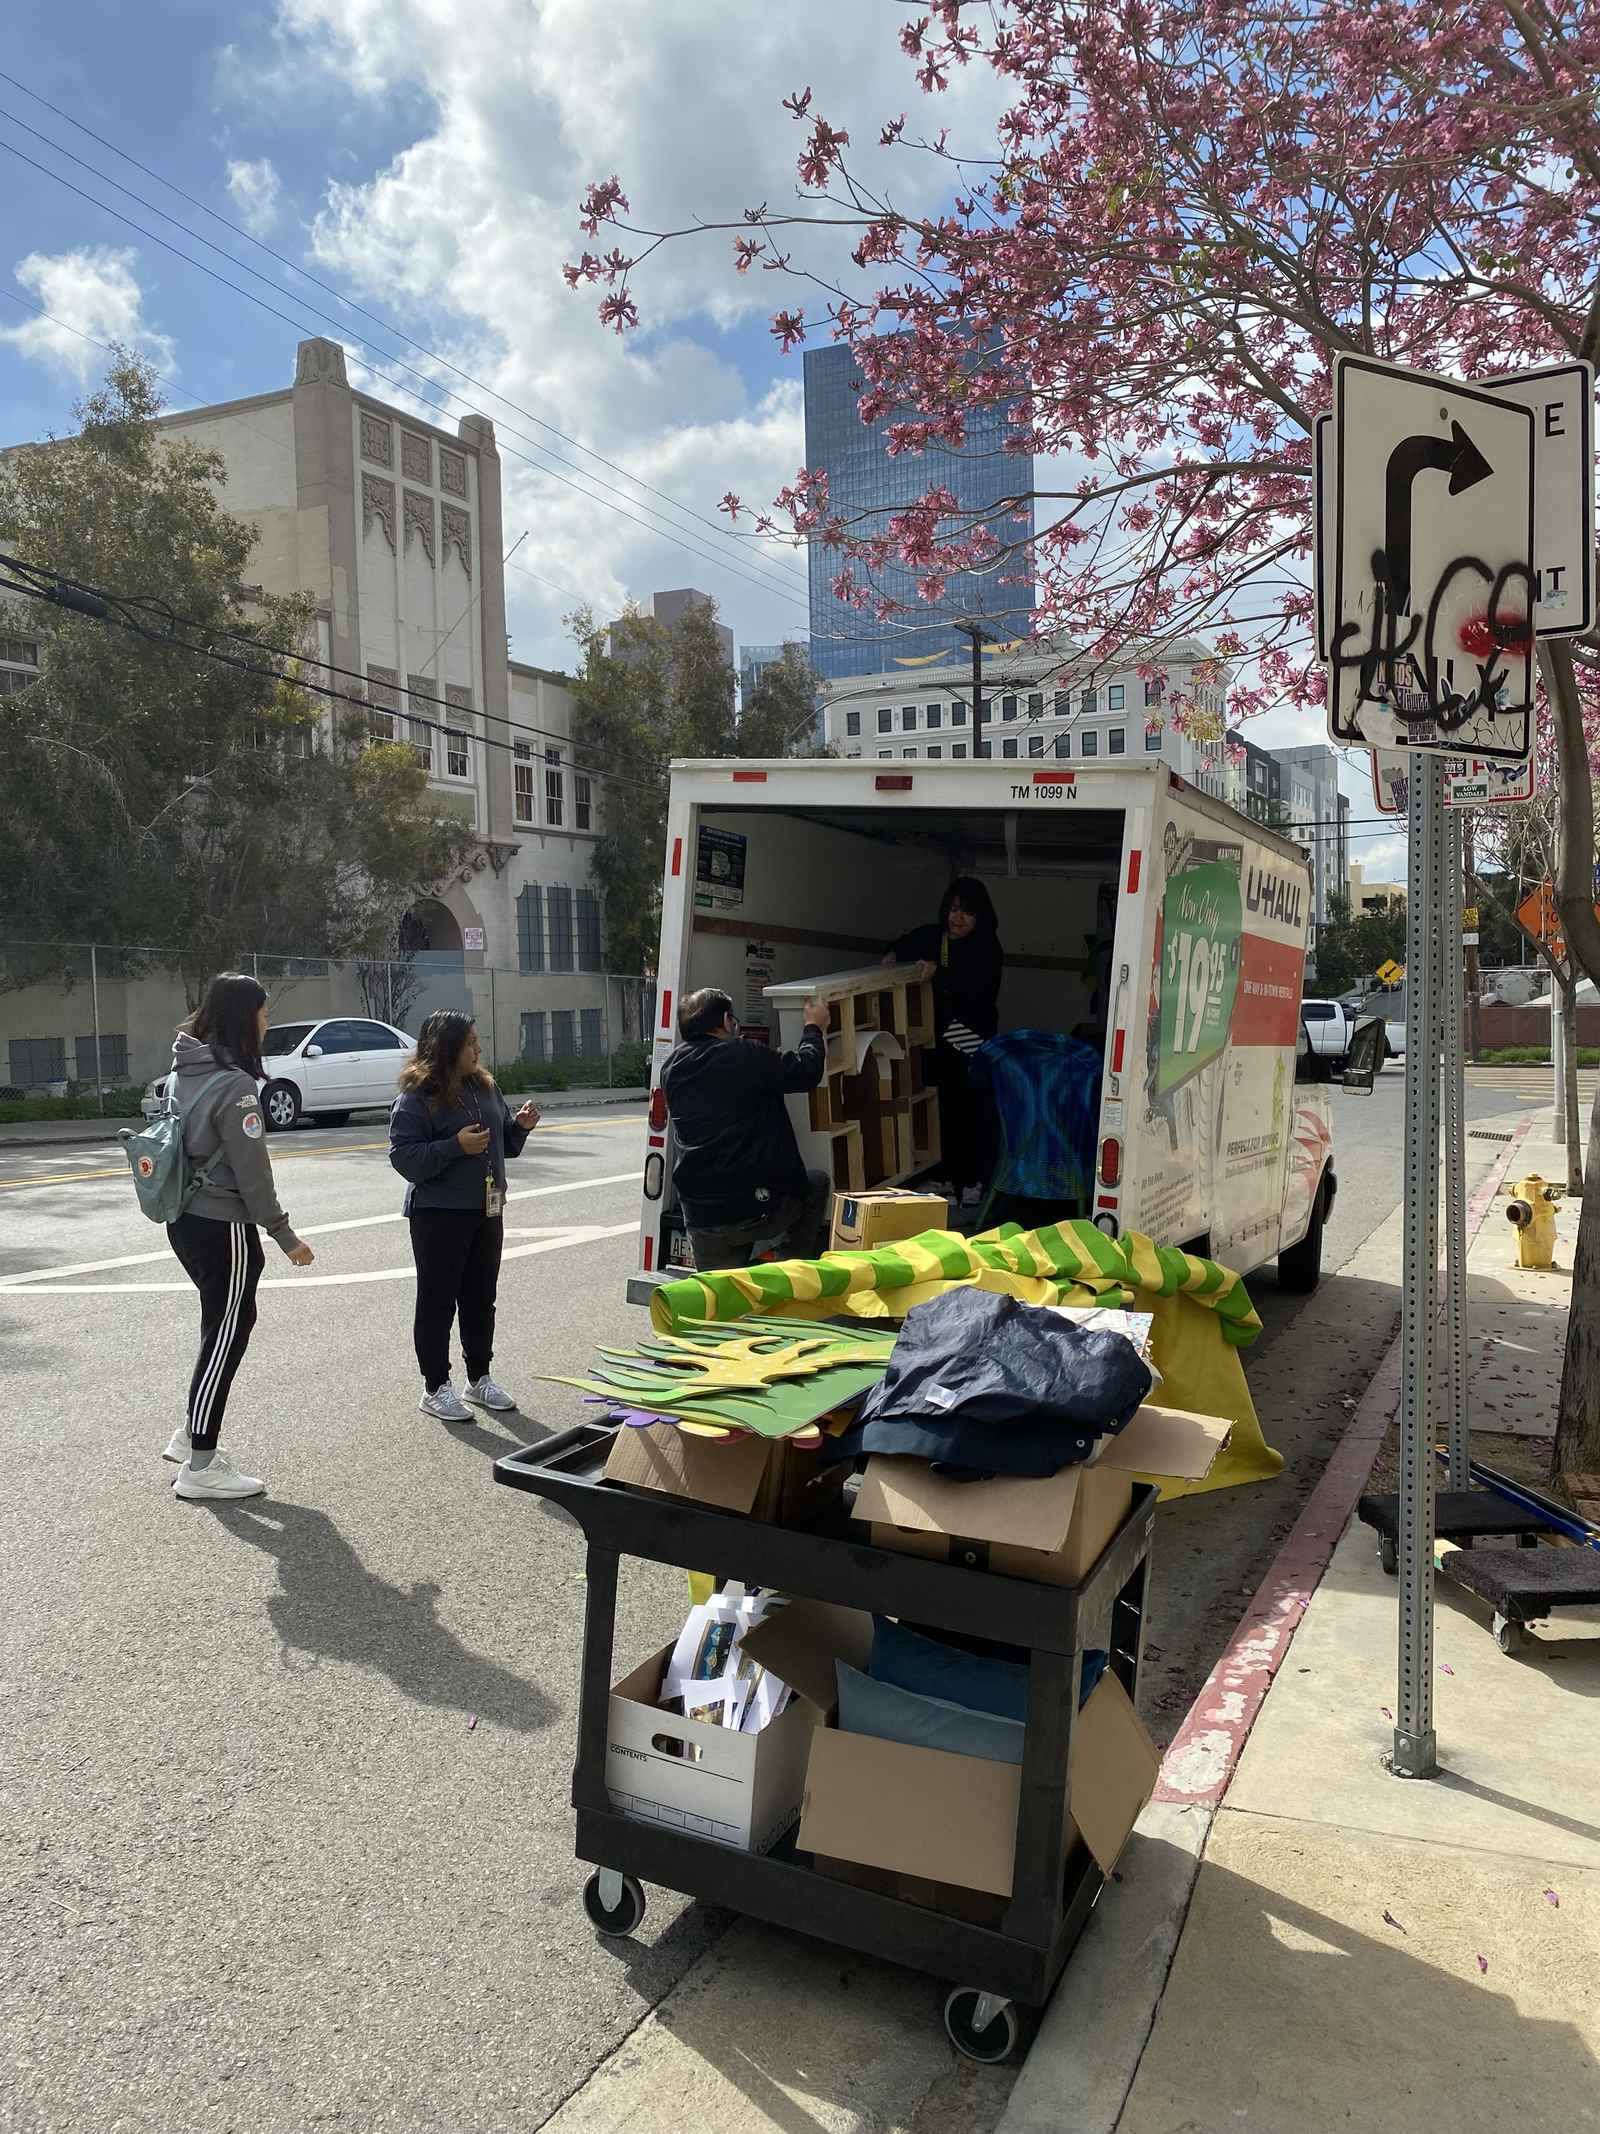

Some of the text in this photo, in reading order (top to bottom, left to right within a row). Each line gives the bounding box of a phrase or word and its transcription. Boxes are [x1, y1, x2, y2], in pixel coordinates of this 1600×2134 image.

[1010, 785, 1077, 799] TM 1099 N
[1246, 864, 1302, 928] U-HAUL
[1198, 889, 1221, 942] Only
[610, 1745, 647, 1762] CONTENTS
